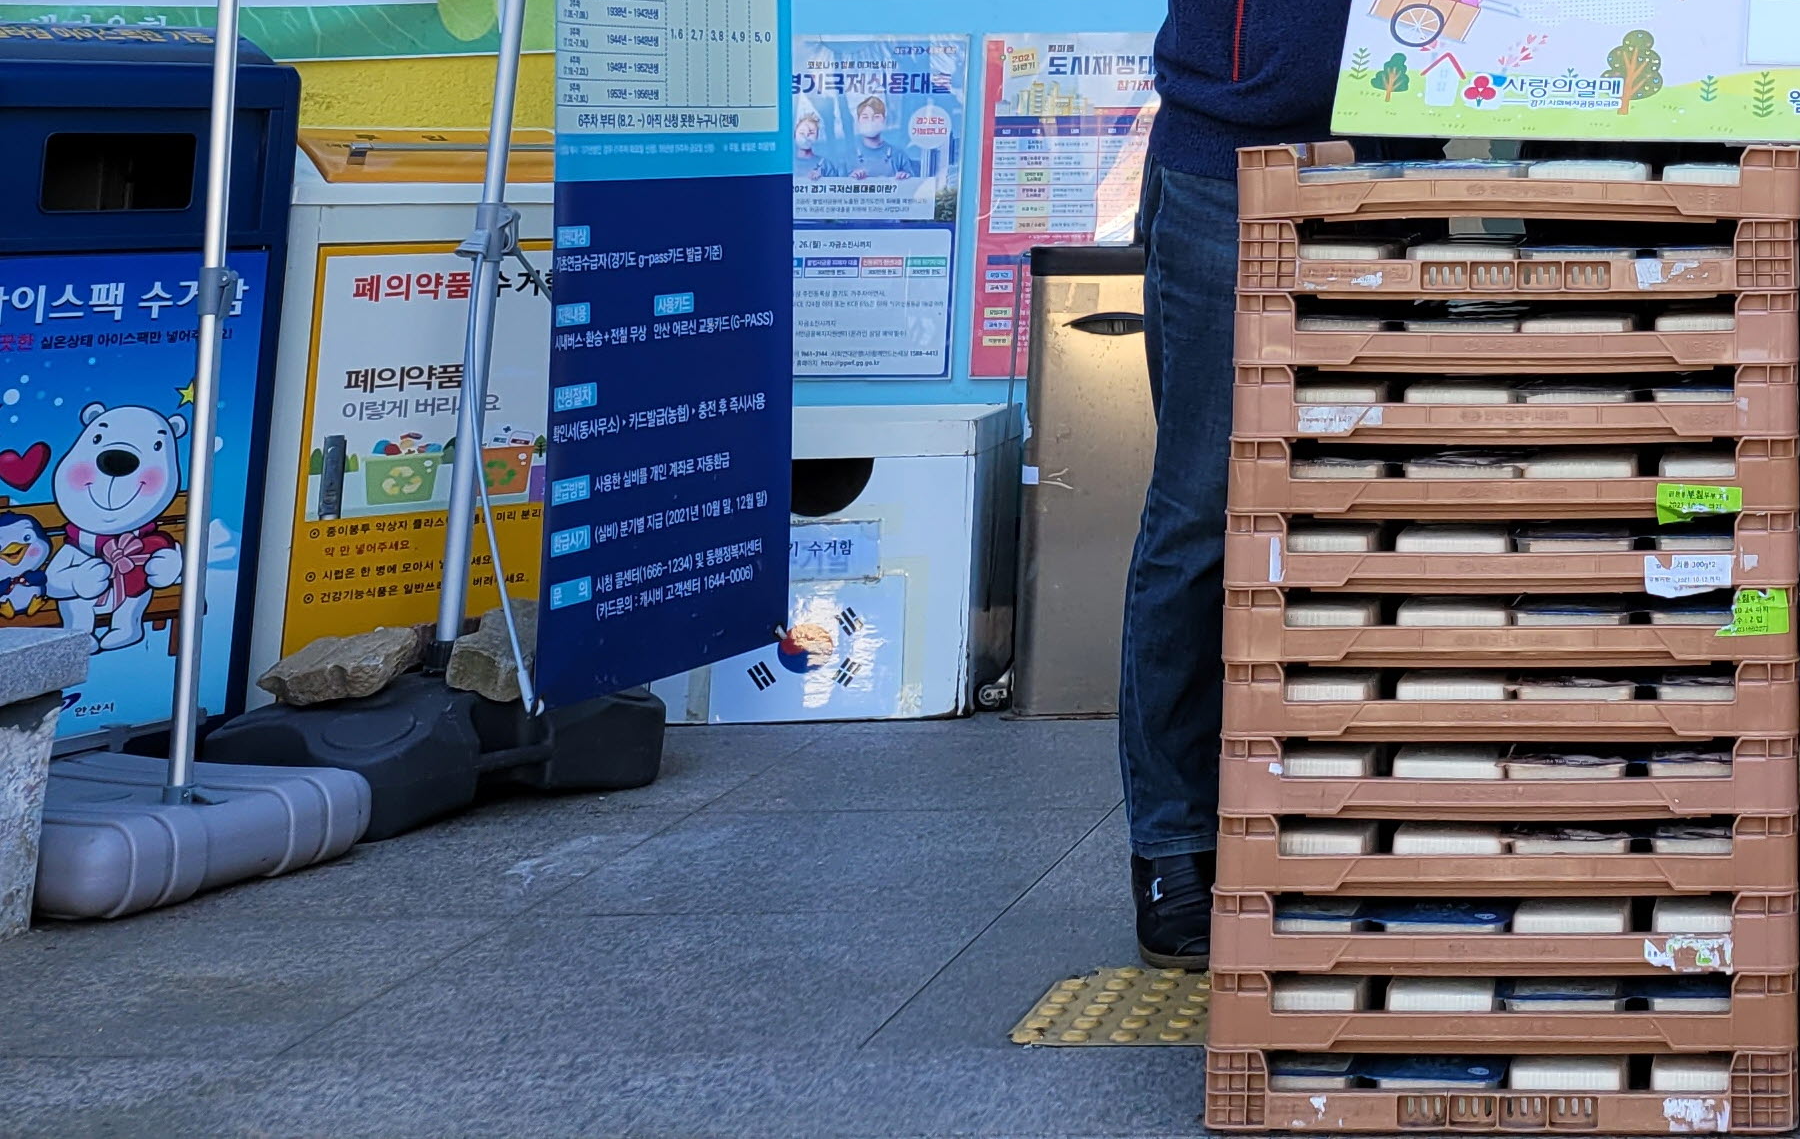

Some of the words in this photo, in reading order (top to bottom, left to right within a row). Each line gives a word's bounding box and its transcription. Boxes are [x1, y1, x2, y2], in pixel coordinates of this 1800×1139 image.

[1503, 78, 1621, 98] 사랑의열매
[556, 386, 592, 408] 신청절차
[553, 414, 620, 444] 확인서(동사무소)
[629, 404, 689, 430] 카드발급(농협)
[699, 401, 716, 420] 충전
[718, 398, 727, 415] 후
[730, 392, 766, 414] 즉시사용
[808, 538, 854, 557] 수거함
[596, 573, 613, 594] 시청
[615, 554, 693, 586] 콜센터(1666-1234)
[695, 552, 704, 569] 및
[706, 537, 763, 566] 동행정복지센터
